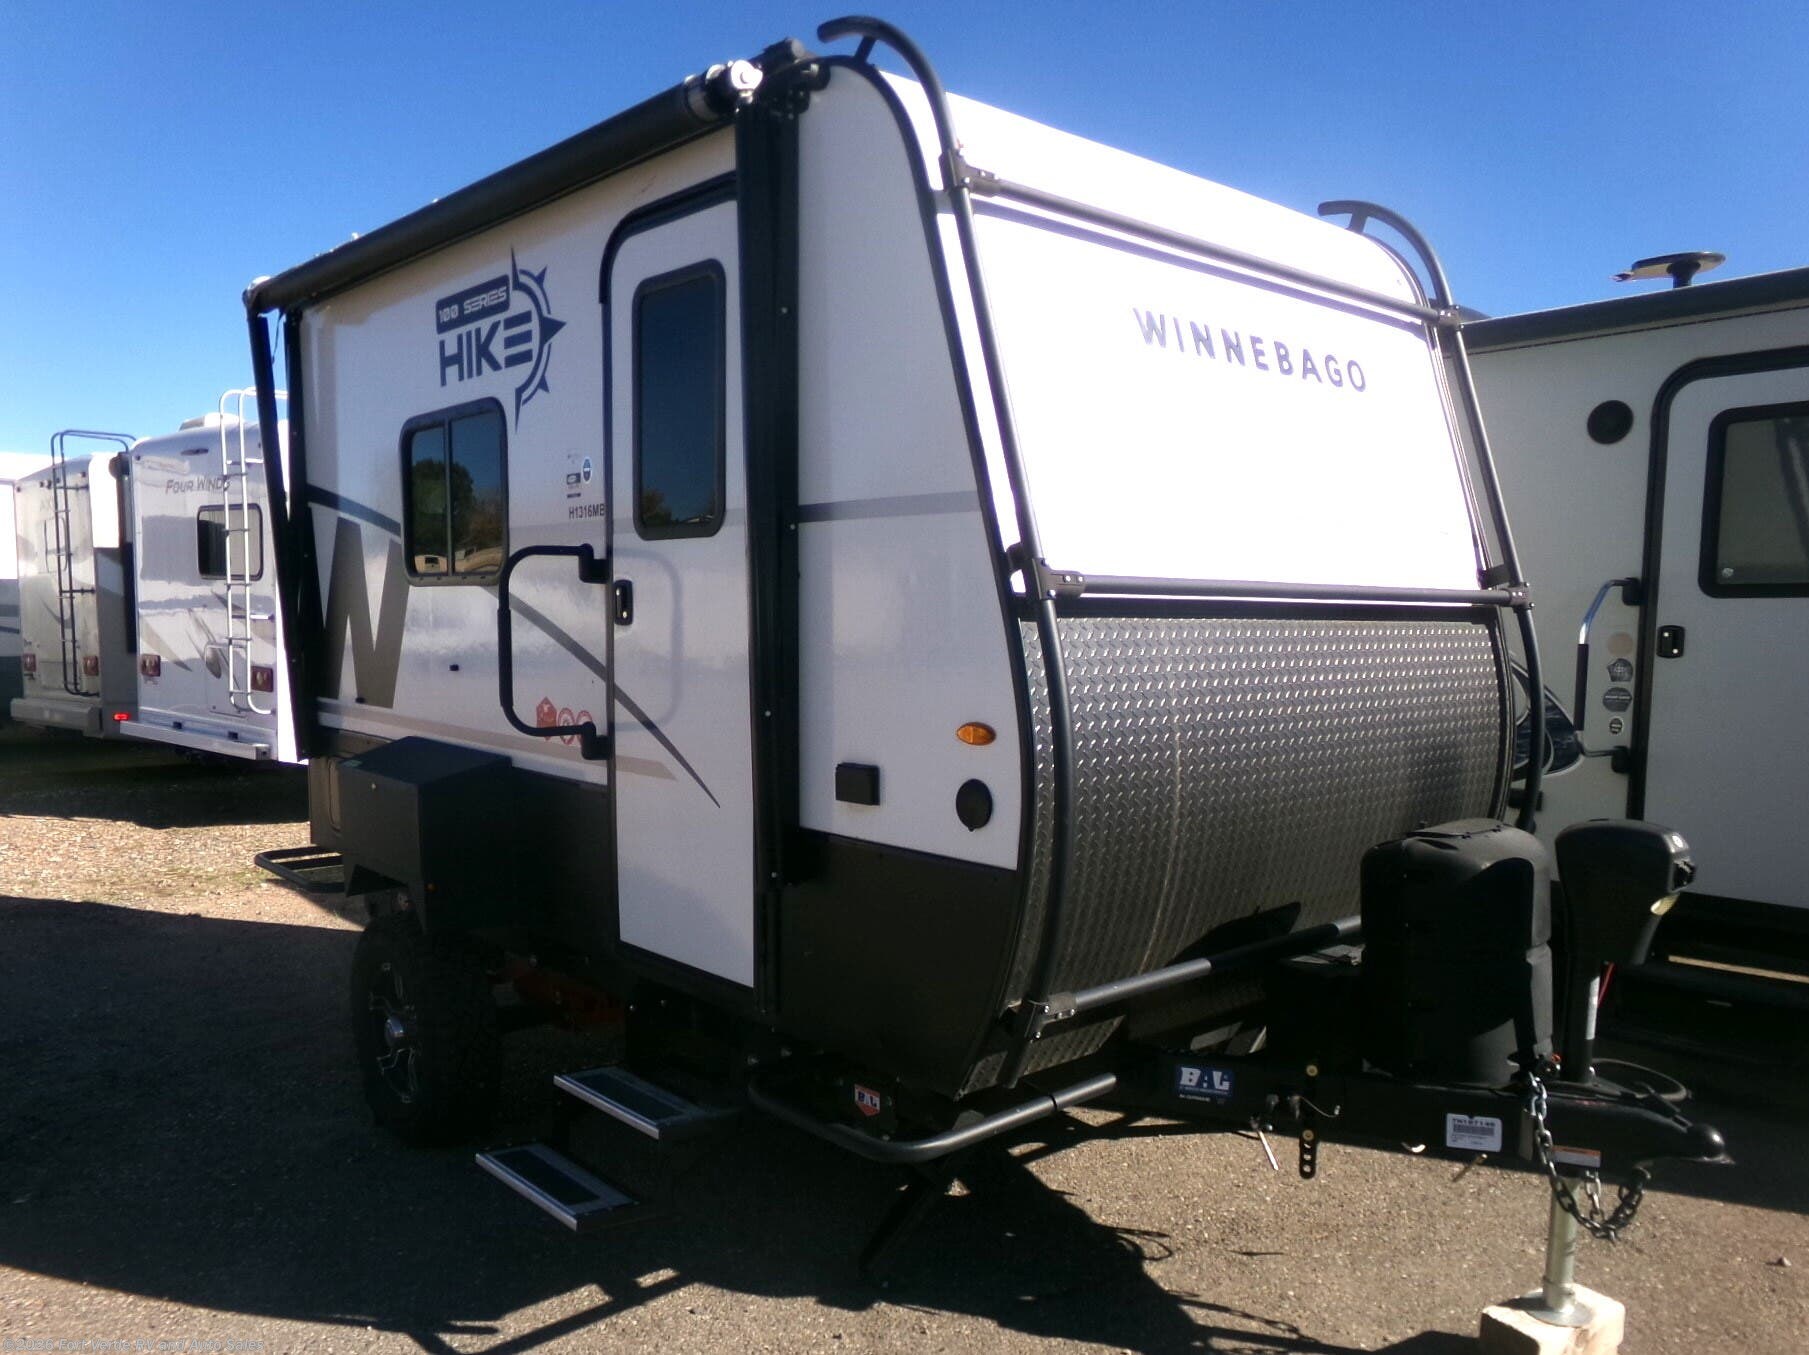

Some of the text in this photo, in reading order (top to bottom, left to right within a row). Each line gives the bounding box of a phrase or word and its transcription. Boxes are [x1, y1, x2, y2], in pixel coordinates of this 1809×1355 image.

[439, 286, 507, 324] 100 SERIES
[439, 310, 533, 387] HIKE
[1133, 307, 1367, 393] WINNEBAGO
[165, 479, 194, 494] FOUR
